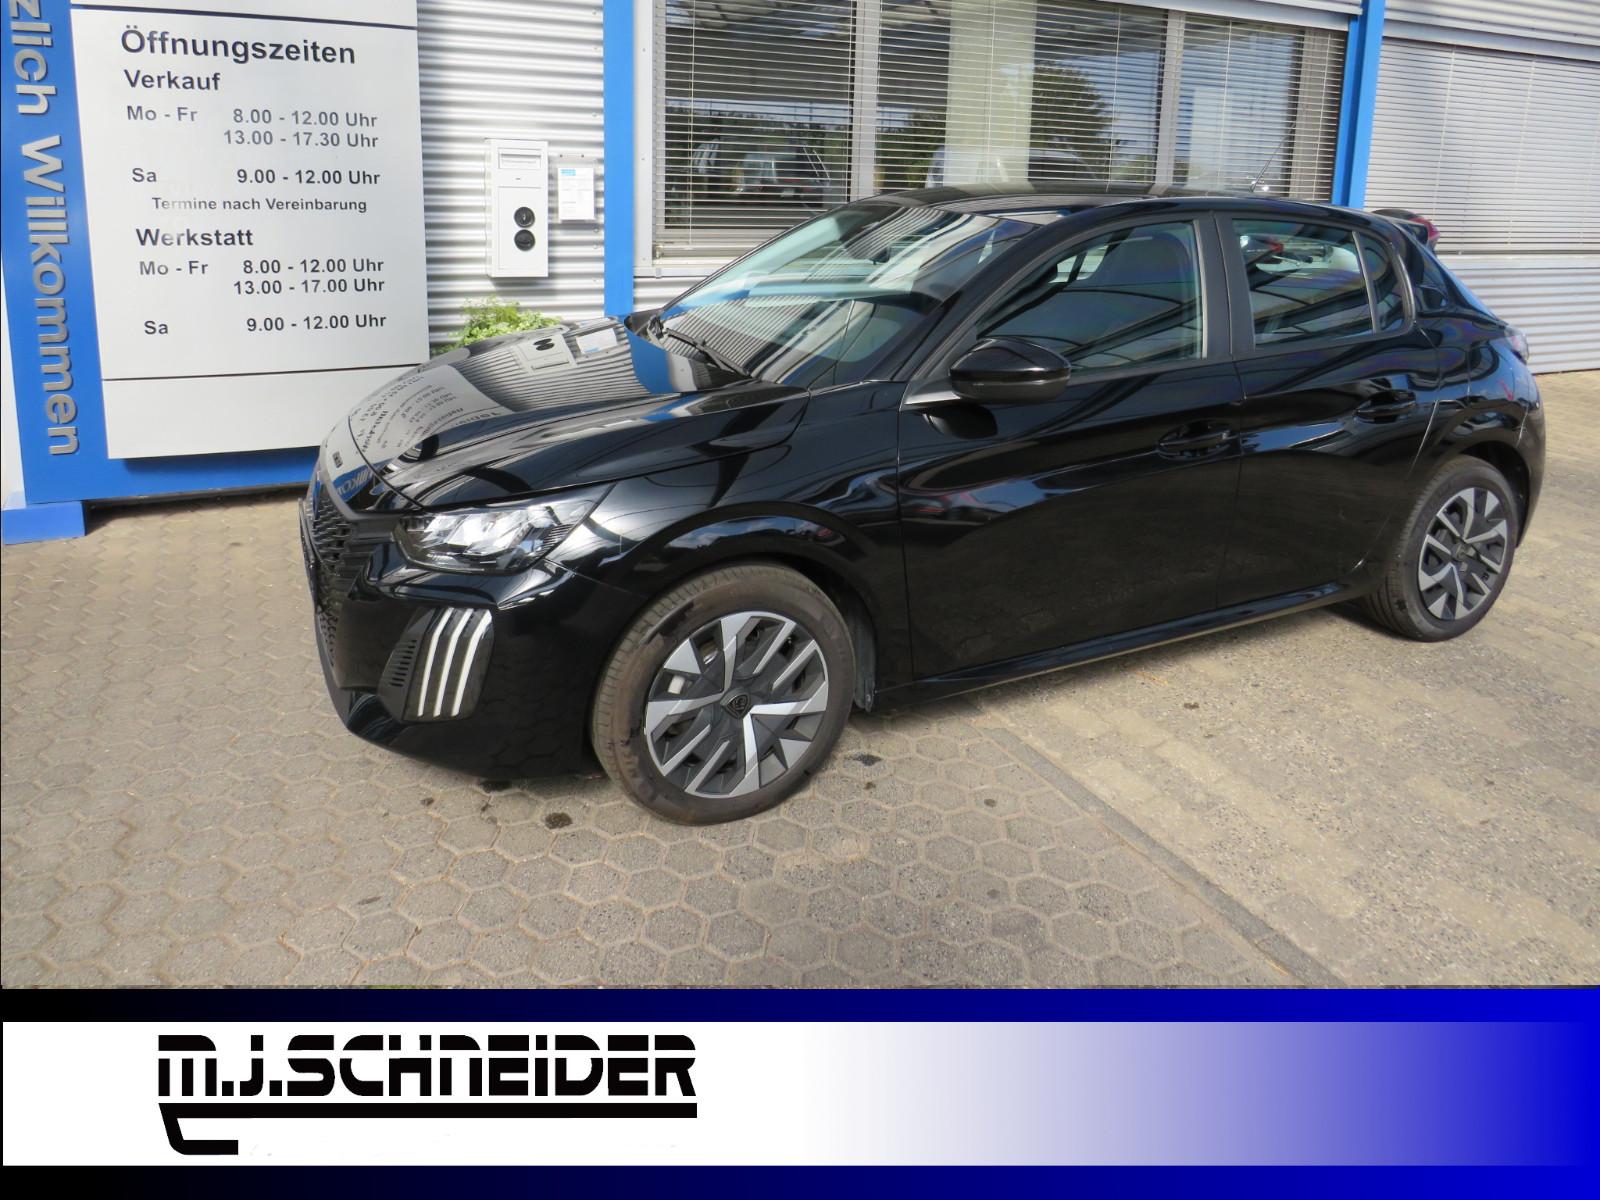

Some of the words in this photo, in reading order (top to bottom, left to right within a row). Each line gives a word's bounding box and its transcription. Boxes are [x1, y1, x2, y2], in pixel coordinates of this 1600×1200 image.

[121, 25, 355, 64] Öffnungszeiten
[123, 69, 220, 90] Verkauf
[127, 105, 157, 121] Mo
[177, 107, 198, 121] Fr
[233, 109, 272, 124] 8.00
[292, 110, 339, 126] 12.00
[346, 112, 378, 127] Uhr
[224, 130, 273, 145] 13.00
[293, 132, 340, 146] 17.30
[347, 133, 379, 147] Uhr
[132, 168, 157, 182] Sa
[237, 169, 275, 183] 9.00
[295, 170, 342, 184] 12.00
[349, 170, 380, 184] Uhr
[152, 197, 217, 209] Termine
[223, 198, 260, 210] nach
[265, 198, 367, 213] Vereinbarung
[136, 228, 253, 246] Werkstatt
[140, 261, 169, 275] Mo
[188, 261, 208, 275] Fr
[243, 260, 281, 274] 8.00
[300, 259, 346, 273] 12.00
[353, 258, 384, 272] Uhr
[21, 134, 80, 456] Willkommen
[234, 280, 282, 295] 13.00
[301, 279, 347, 294] 17.00
[354, 278, 385, 292] Uhr
[144, 321, 168, 335] Sa
[247, 317, 284, 332] 9.00
[303, 315, 349, 330] 12.00
[356, 314, 387, 328] Uhr
